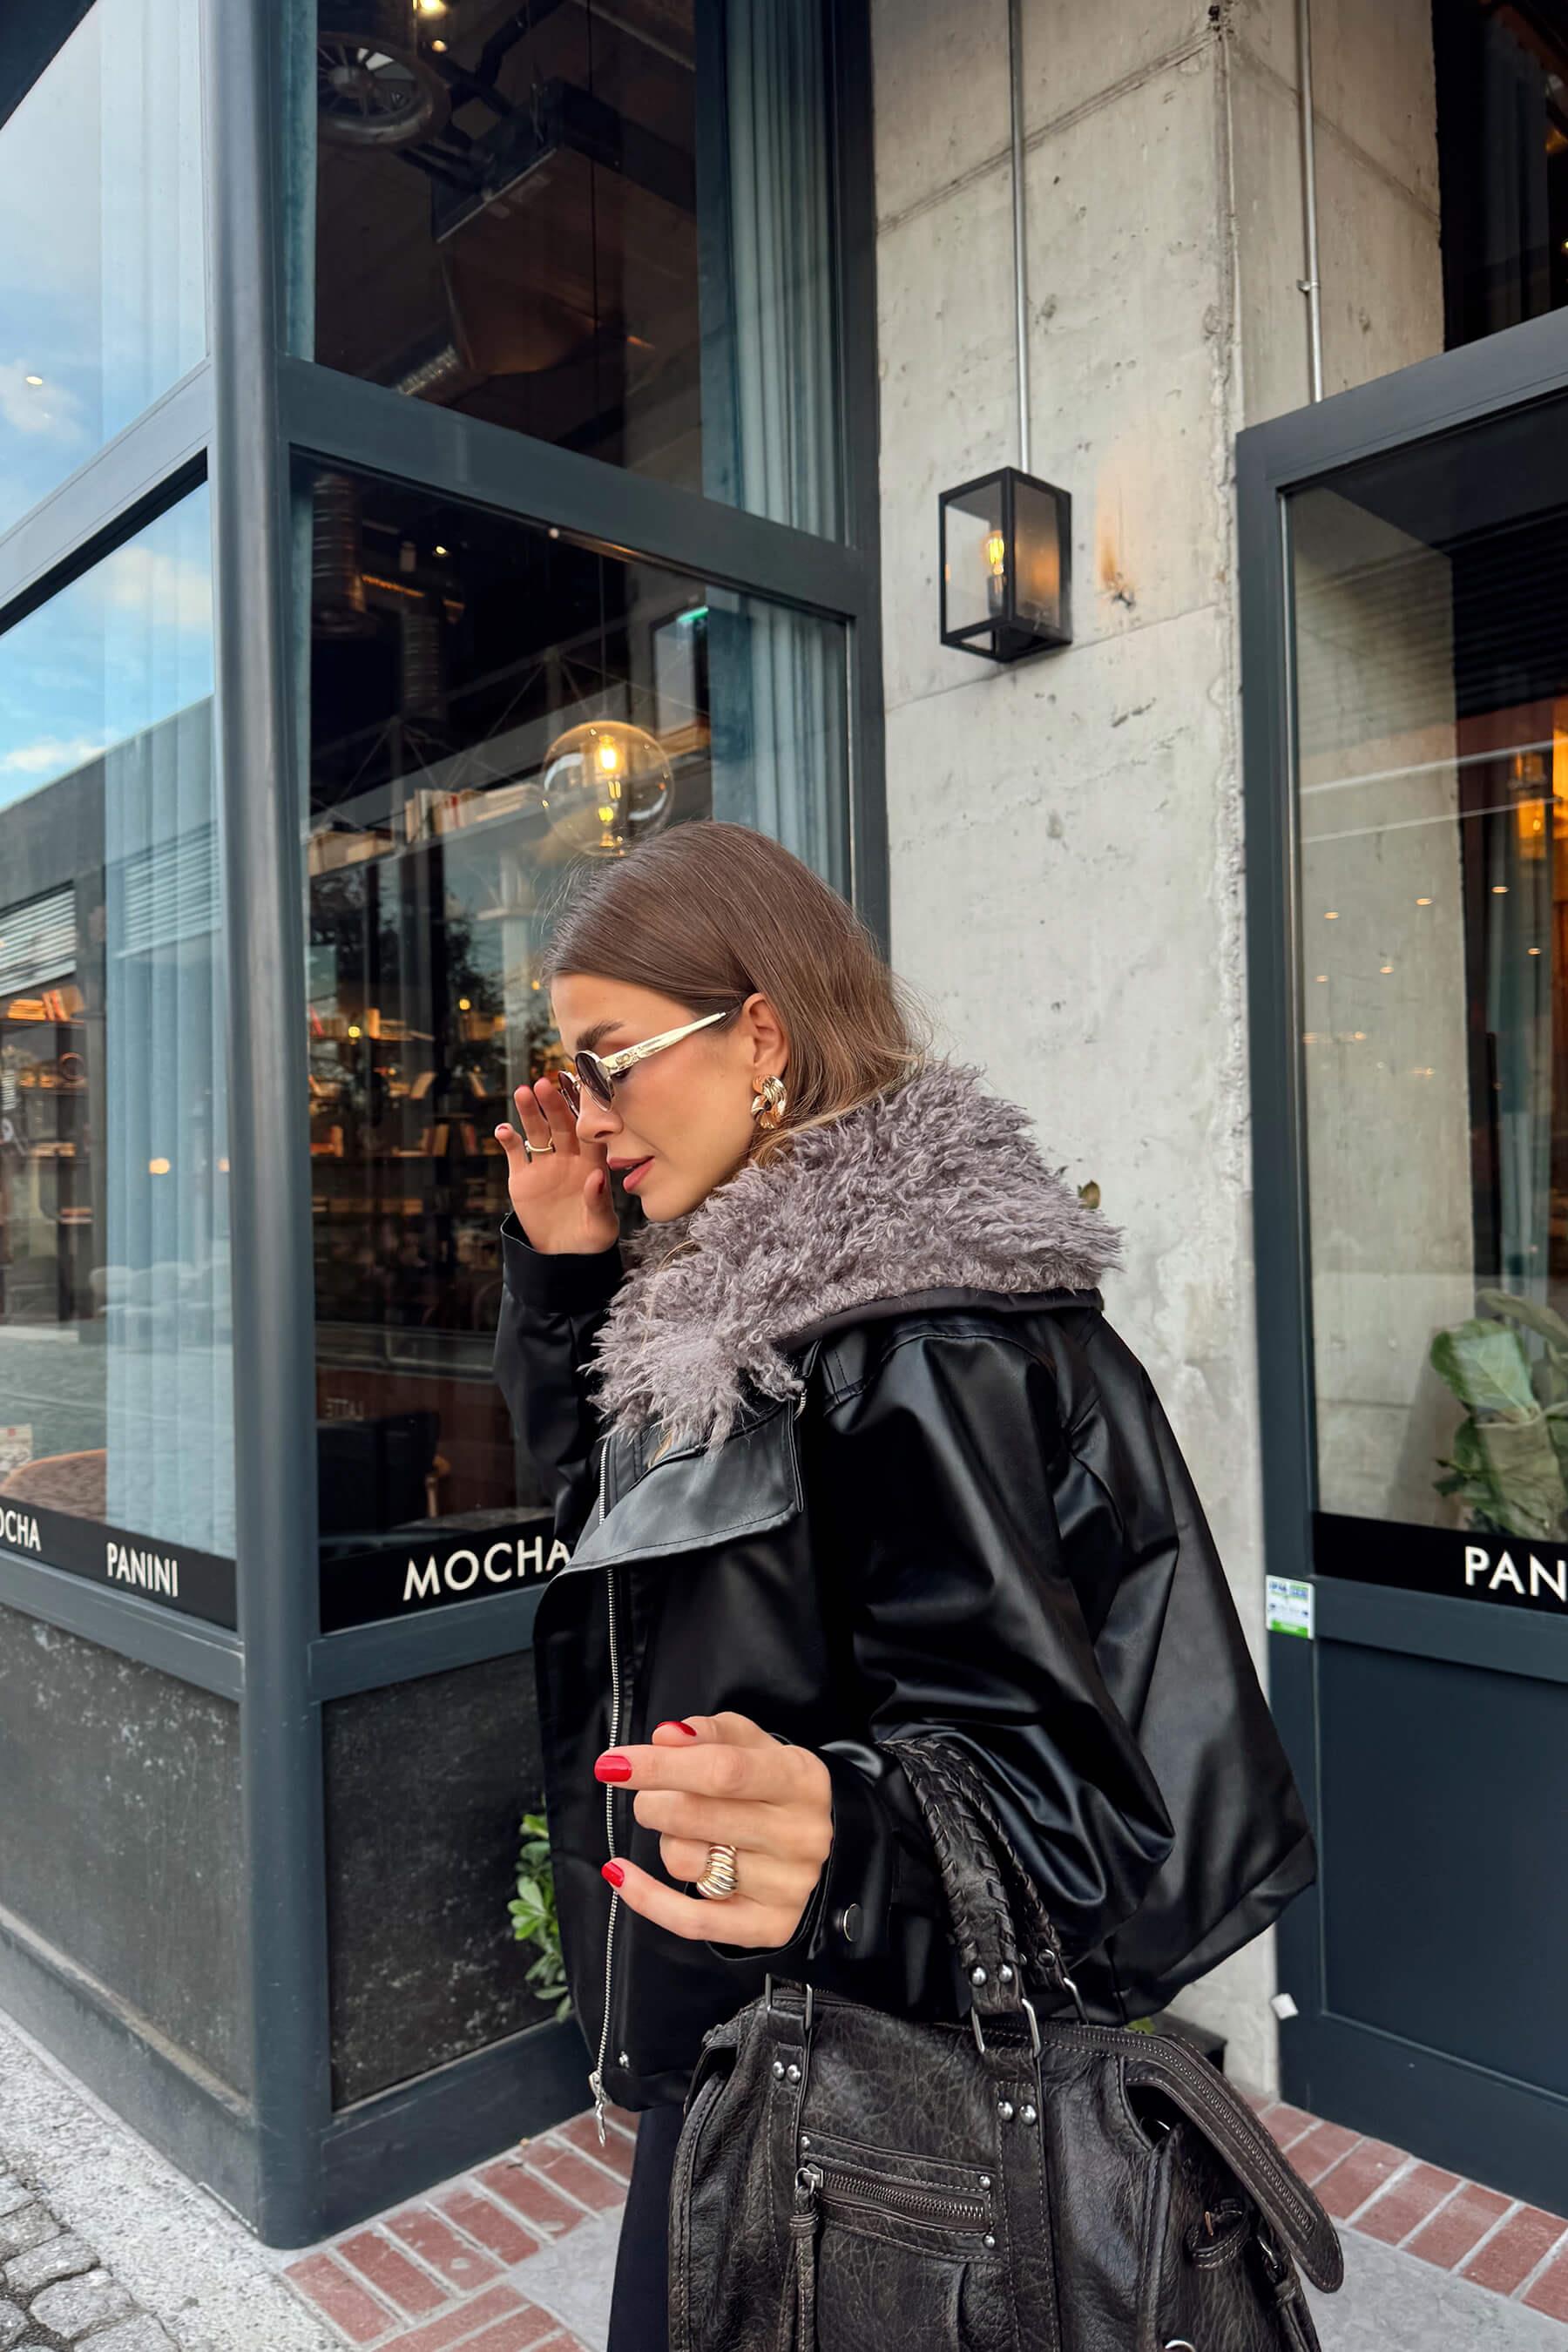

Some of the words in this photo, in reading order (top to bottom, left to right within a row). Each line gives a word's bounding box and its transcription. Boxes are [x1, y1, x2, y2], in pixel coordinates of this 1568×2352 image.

[106, 1541, 179, 1598] PANINI
[402, 1536, 571, 1601] MOCHA
[1464, 1545, 1567, 1602] PAN
